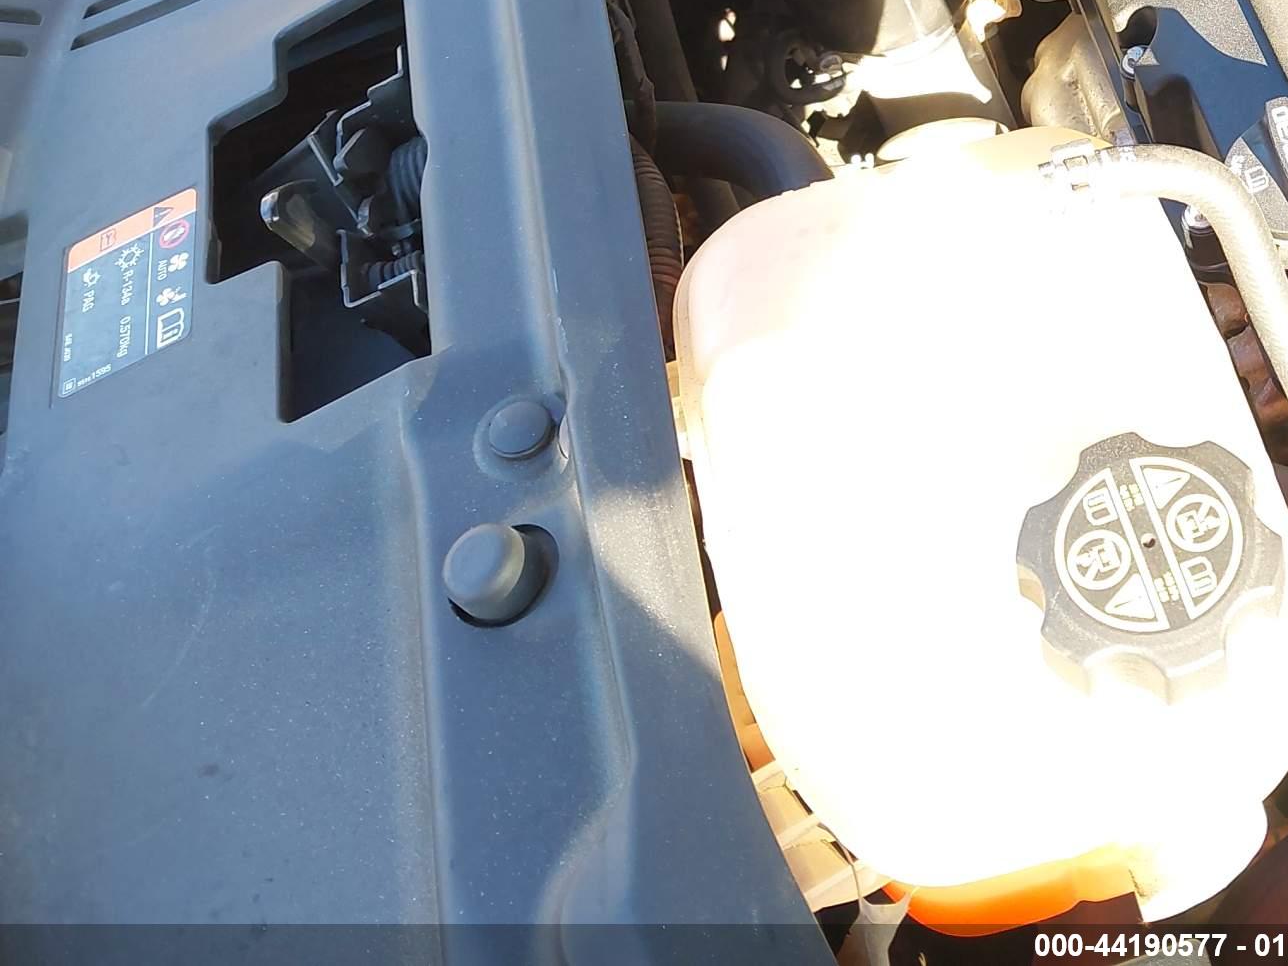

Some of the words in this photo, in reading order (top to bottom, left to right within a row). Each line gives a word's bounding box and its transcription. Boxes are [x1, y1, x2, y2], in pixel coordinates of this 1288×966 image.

[157, 259, 168, 281] AUTO
[120, 270, 134, 306] R-134a
[82, 290, 95, 313] PAG
